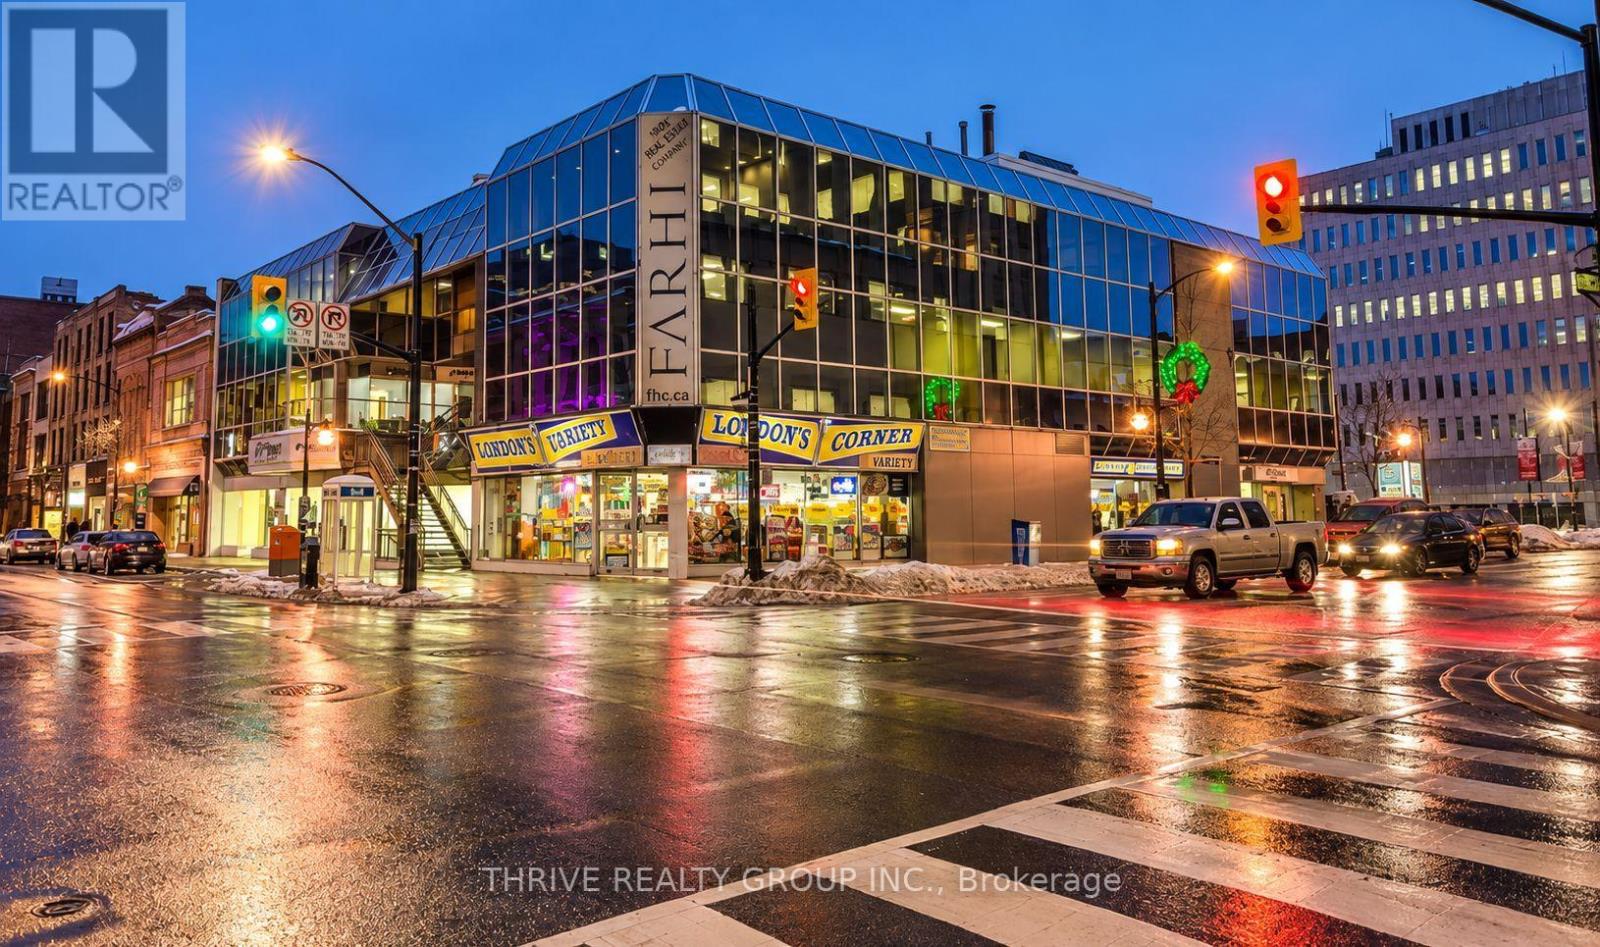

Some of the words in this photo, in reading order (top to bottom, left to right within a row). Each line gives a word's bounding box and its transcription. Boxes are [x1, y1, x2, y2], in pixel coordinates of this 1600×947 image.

[649, 182, 687, 377] FARHI
[646, 388, 690, 402] fhc.ca
[475, 436, 536, 459] LONDON'S
[546, 419, 606, 454] VARIETY
[831, 428, 914, 452] CORNER
[872, 456, 913, 469] VARIETY
